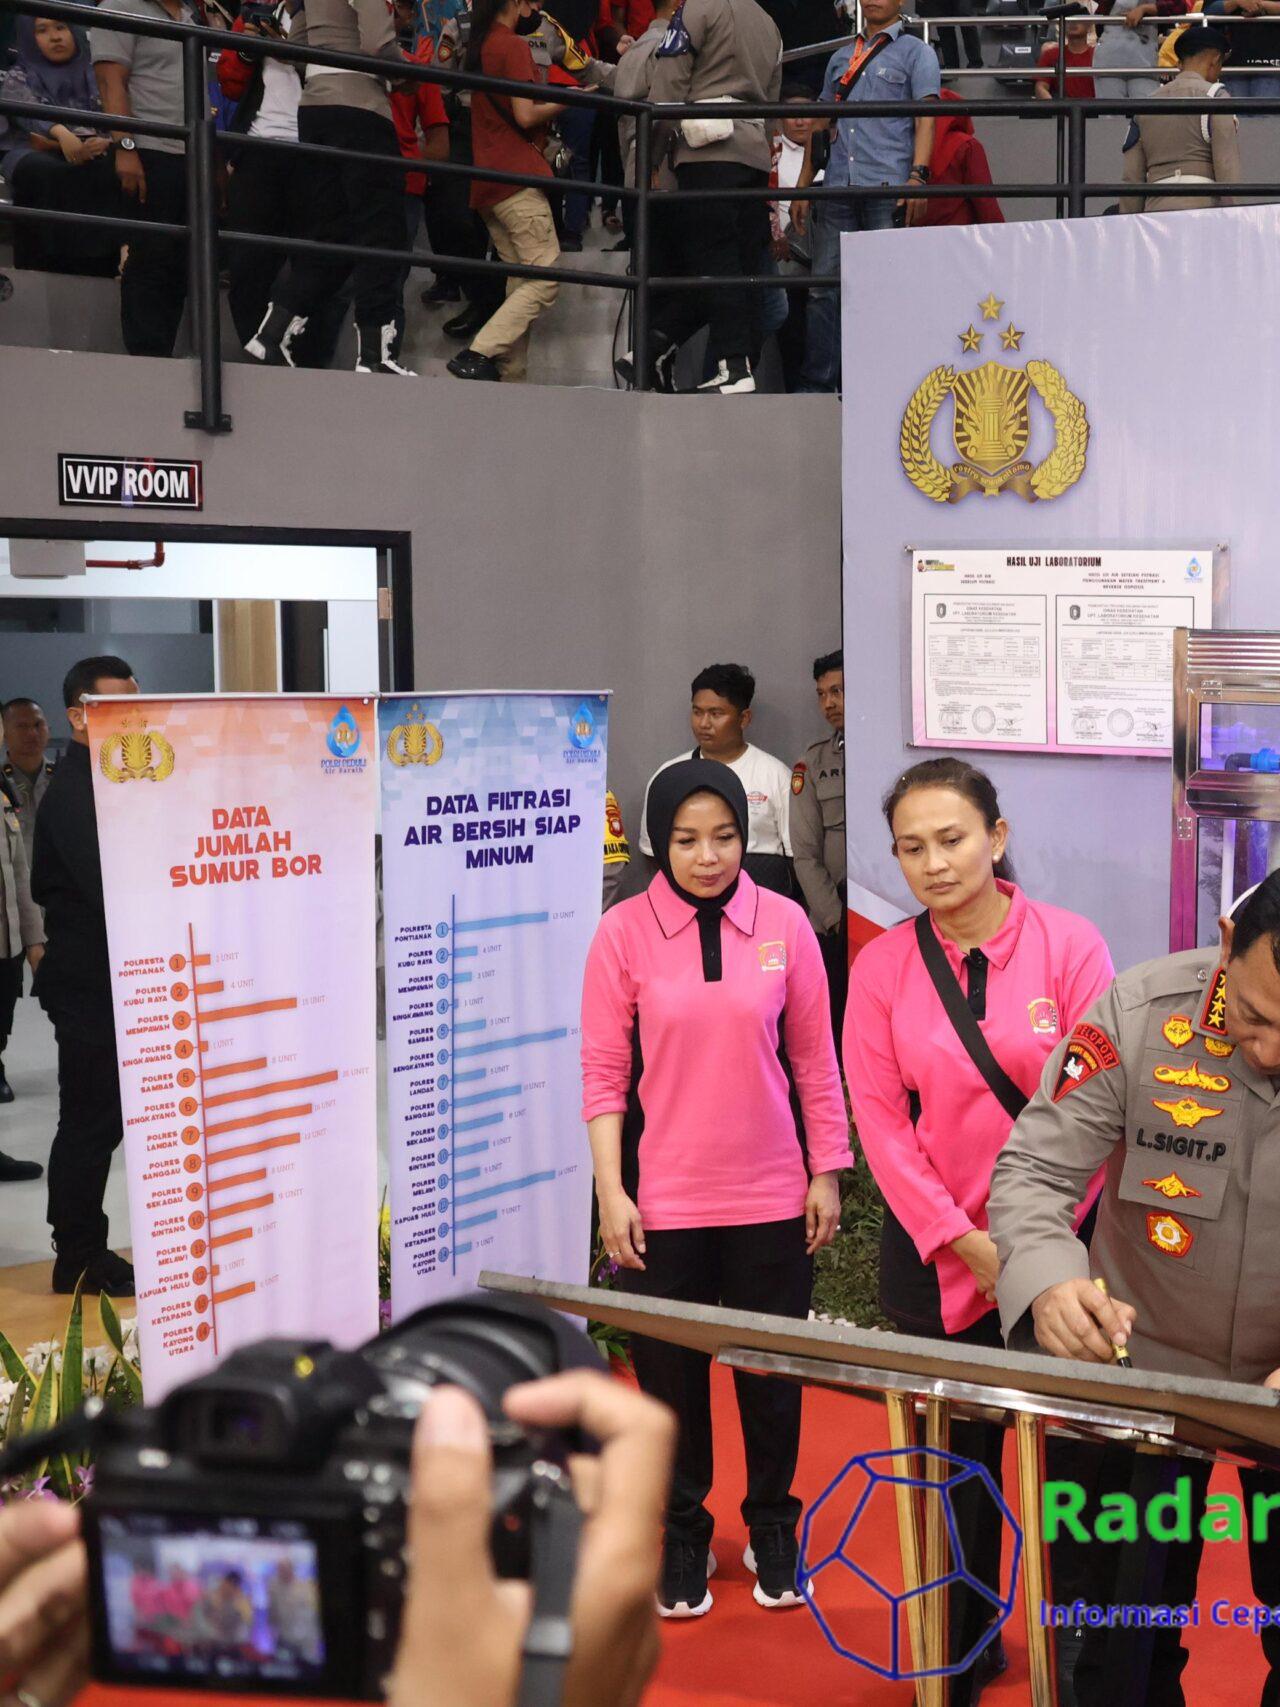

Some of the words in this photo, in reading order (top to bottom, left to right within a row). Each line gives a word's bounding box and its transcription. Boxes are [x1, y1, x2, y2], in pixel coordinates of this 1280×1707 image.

[67, 464, 119, 495] VVIP
[124, 467, 189, 499] ROOM
[1006, 556, 1027, 567] HASIL
[1028, 556, 1041, 567] UJI
[1045, 556, 1102, 568] LABORATORIUM
[426, 793, 479, 816] DATA
[488, 788, 571, 812] FILTRASI
[212, 805, 272, 830] DATA
[404, 824, 443, 847] AIR
[452, 817, 526, 842] BERSIH
[535, 814, 581, 836] SIAP
[194, 830, 292, 859] JUMLAH
[466, 844, 534, 870] MINUM
[169, 859, 260, 888] SUMUR
[272, 854, 322, 879] BOR
[124, 957, 165, 967] POLRESTA
[118, 967, 165, 977] PONTIANAK
[135, 986, 167, 995] POLRES
[123, 998, 145, 1007] KUBU
[137, 1015, 169, 1024] POLRES
[140, 1045, 172, 1054] POLRES
[142, 1073, 173, 1083] POLRES
[144, 1102, 176, 1112] POLRES
[147, 1131, 178, 1141] POLRES
[1136, 1128, 1228, 1163] L.SIGIT.P
[149, 1158, 180, 1169] POLRES
[151, 1187, 182, 1198] POLRES
[154, 1216, 185, 1227] POLRES
[156, 1245, 187, 1256] POLRES
[159, 1273, 189, 1284] POLRES
[161, 1301, 192, 1313] POLRES
[163, 1326, 193, 1338] POLRES
